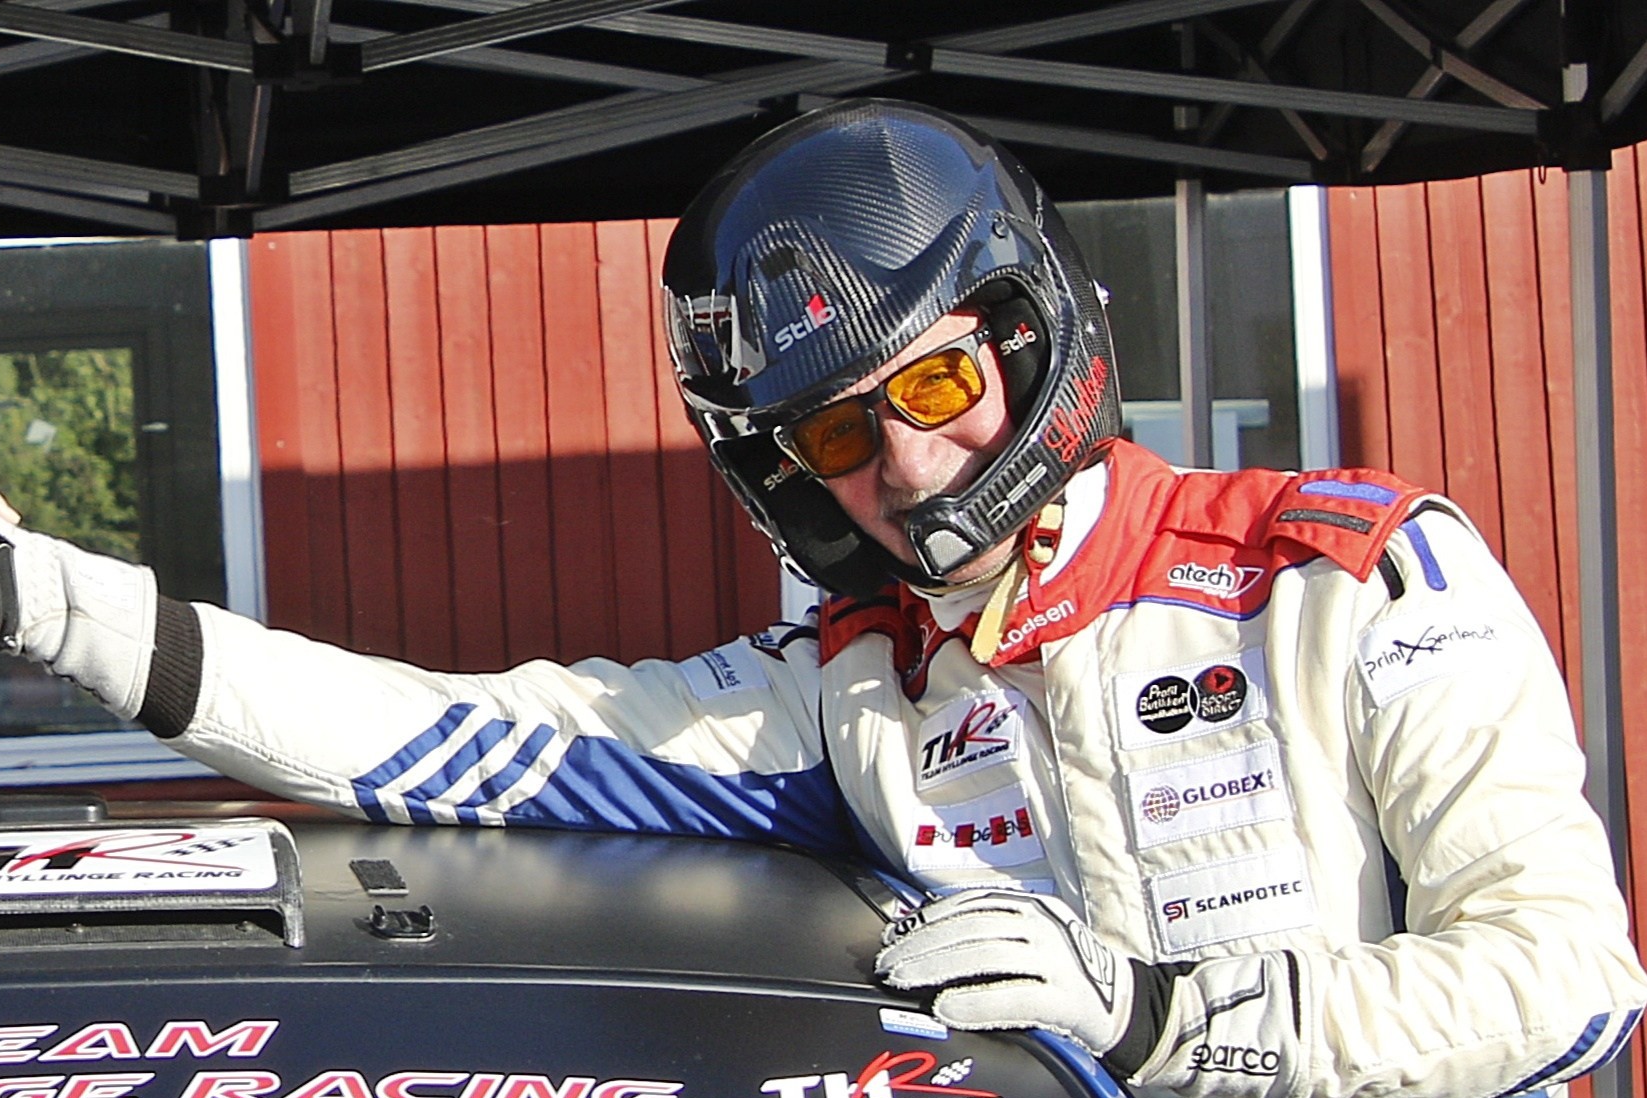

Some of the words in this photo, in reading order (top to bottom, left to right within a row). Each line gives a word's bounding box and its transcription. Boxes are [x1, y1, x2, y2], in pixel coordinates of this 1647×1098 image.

[774, 293, 837, 352] Stilo
[1000, 322, 1037, 356] Stilo
[763, 459, 798, 491] Stilo
[1168, 563, 1233, 588] atech
[1183, 771, 1266, 805] GLOBEX
[133, 869, 244, 881] RACING
[1195, 880, 1303, 913] SCANPOTEC
